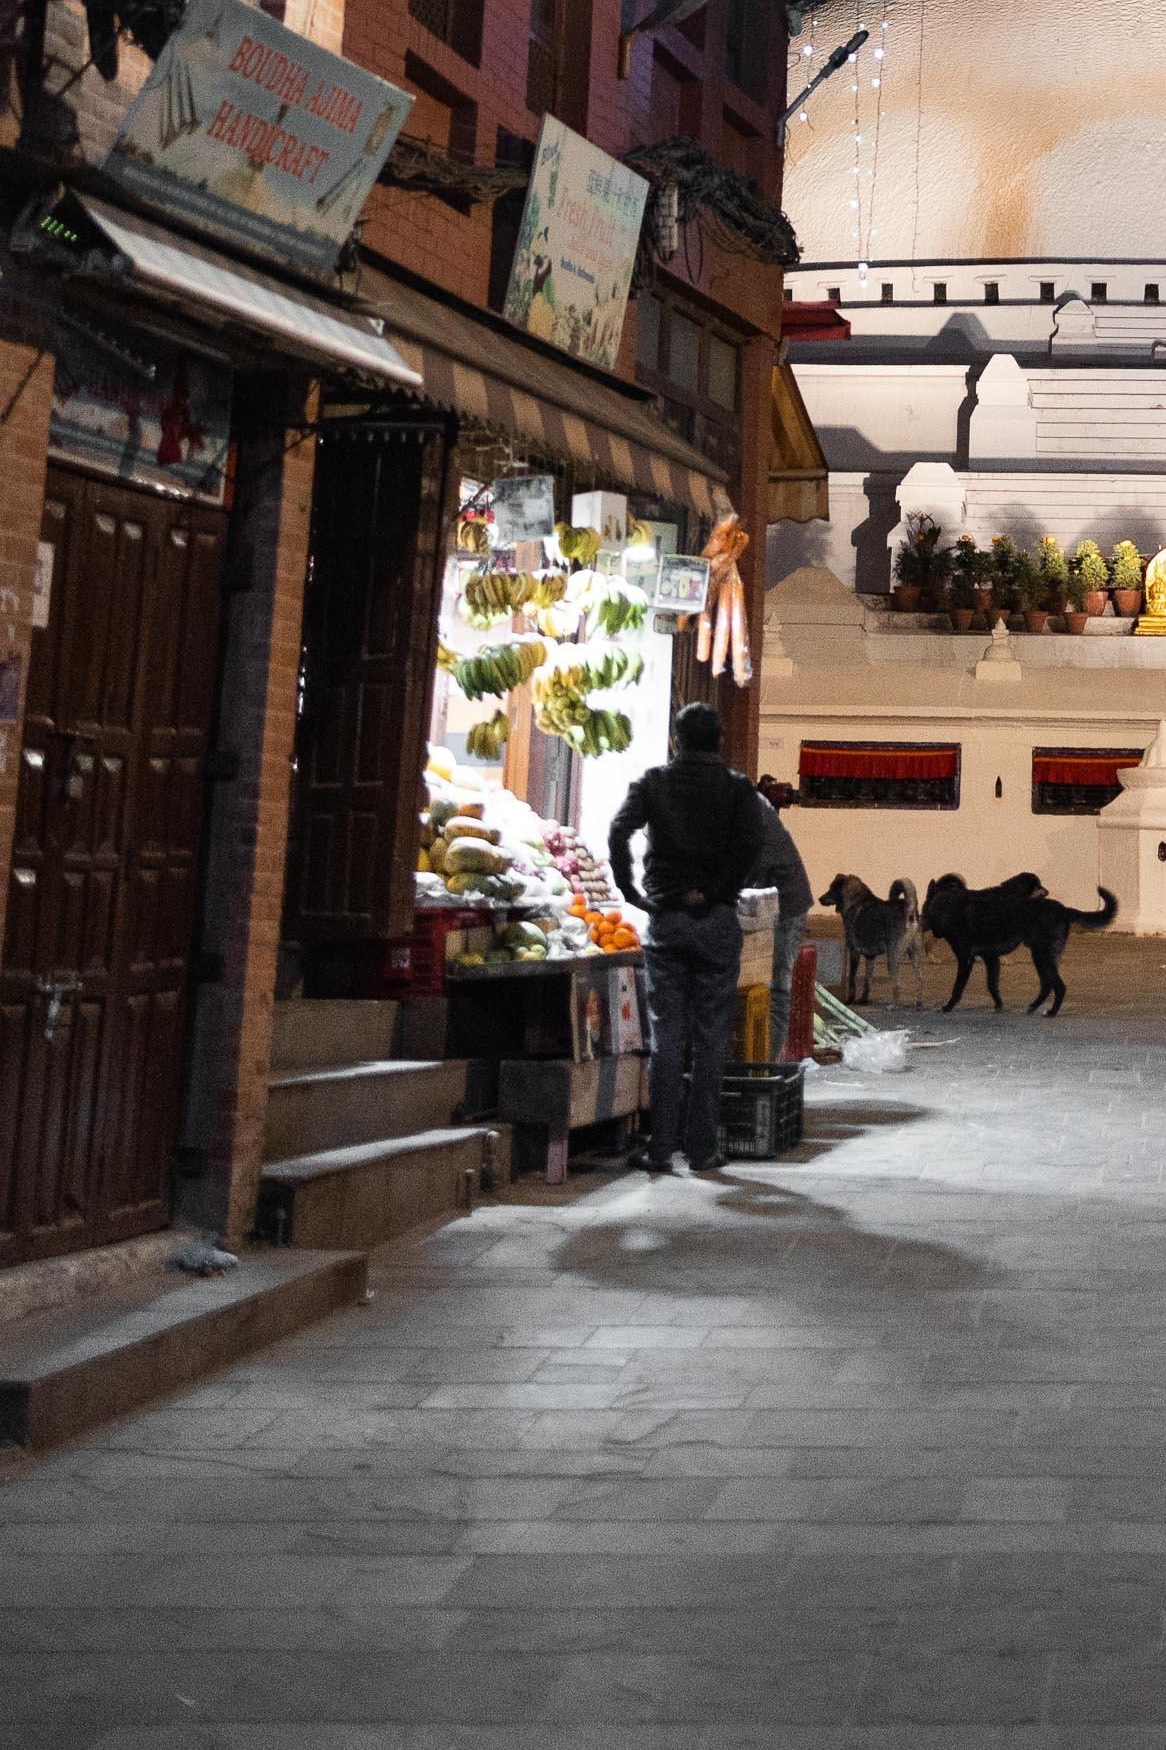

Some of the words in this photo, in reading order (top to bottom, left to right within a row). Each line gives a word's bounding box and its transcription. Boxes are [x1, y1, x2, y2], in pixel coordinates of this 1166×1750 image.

[229, 35, 309, 106] BOUDHA
[304, 81, 364, 135] AJIMA
[206, 100, 330, 185] HANDICRAFT
